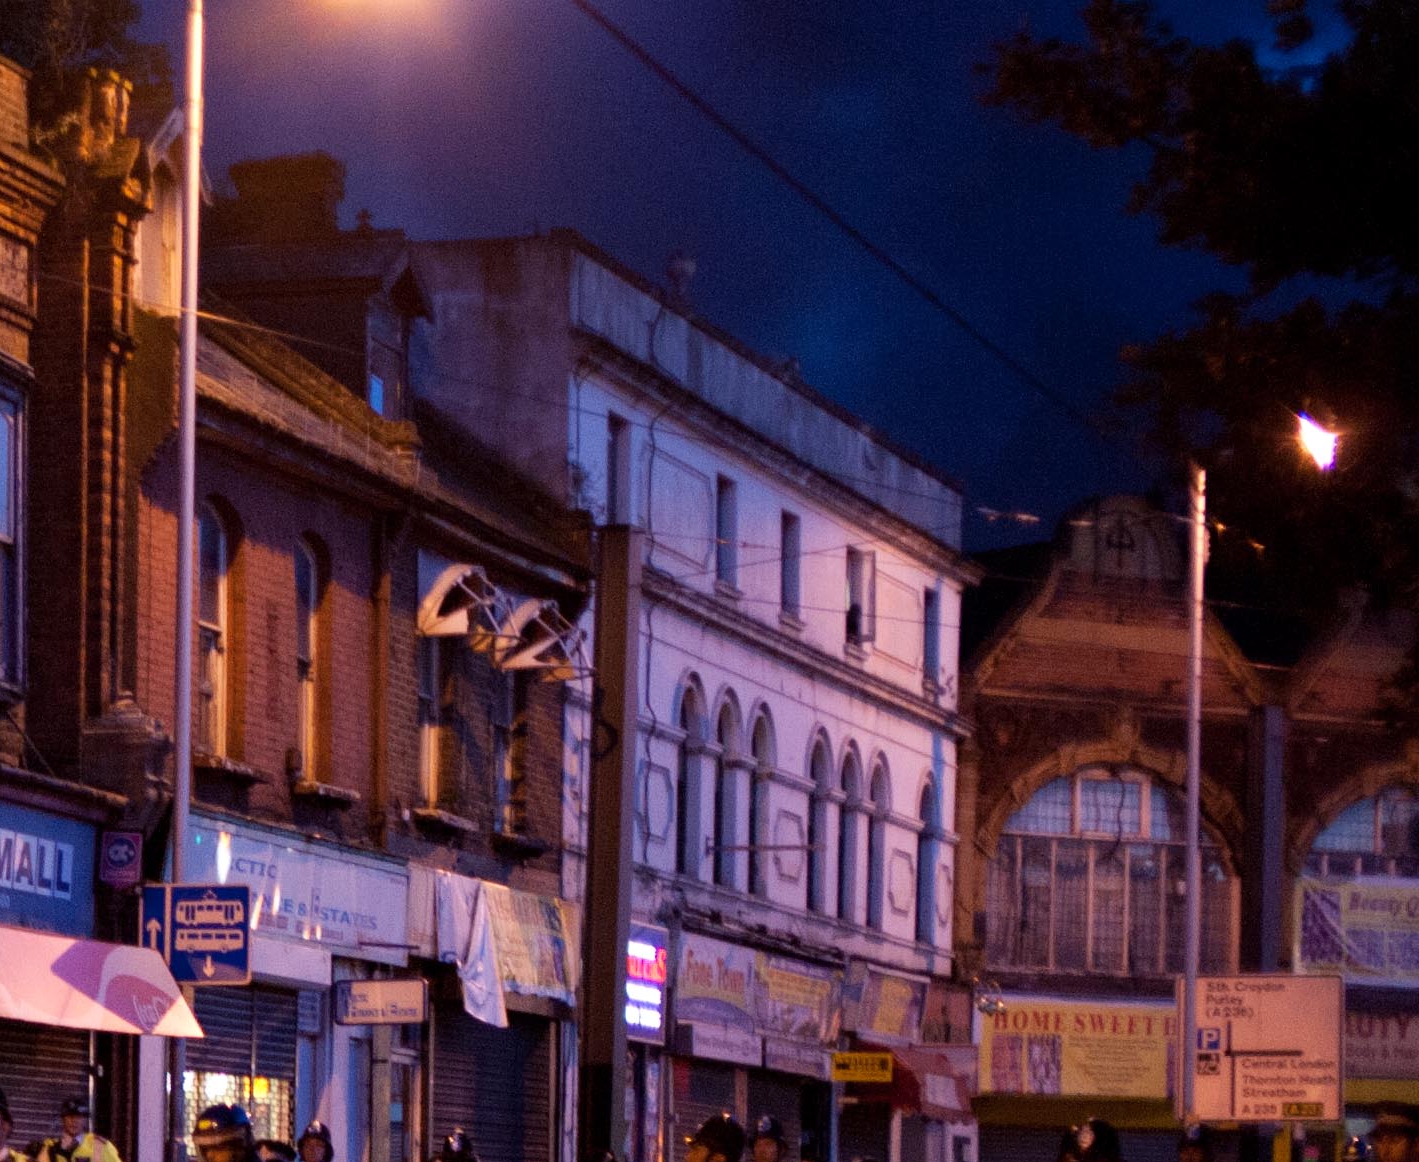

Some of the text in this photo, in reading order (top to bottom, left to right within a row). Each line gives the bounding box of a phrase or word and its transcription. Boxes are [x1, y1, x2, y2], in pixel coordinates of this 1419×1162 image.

[1234, 981, 1285, 995] Croydon
[1206, 994, 1243, 1007] Purley
[993, 1010, 1067, 1031] HOME
[1073, 1011, 1154, 1036] SWEET
[1201, 1030, 1219, 1050] P
[1241, 1059, 1287, 1069] Central
[1291, 1059, 1335, 1069] London
[1241, 1075, 1296, 1085] Thornton
[1241, 1088, 1307, 1098] Streatham
